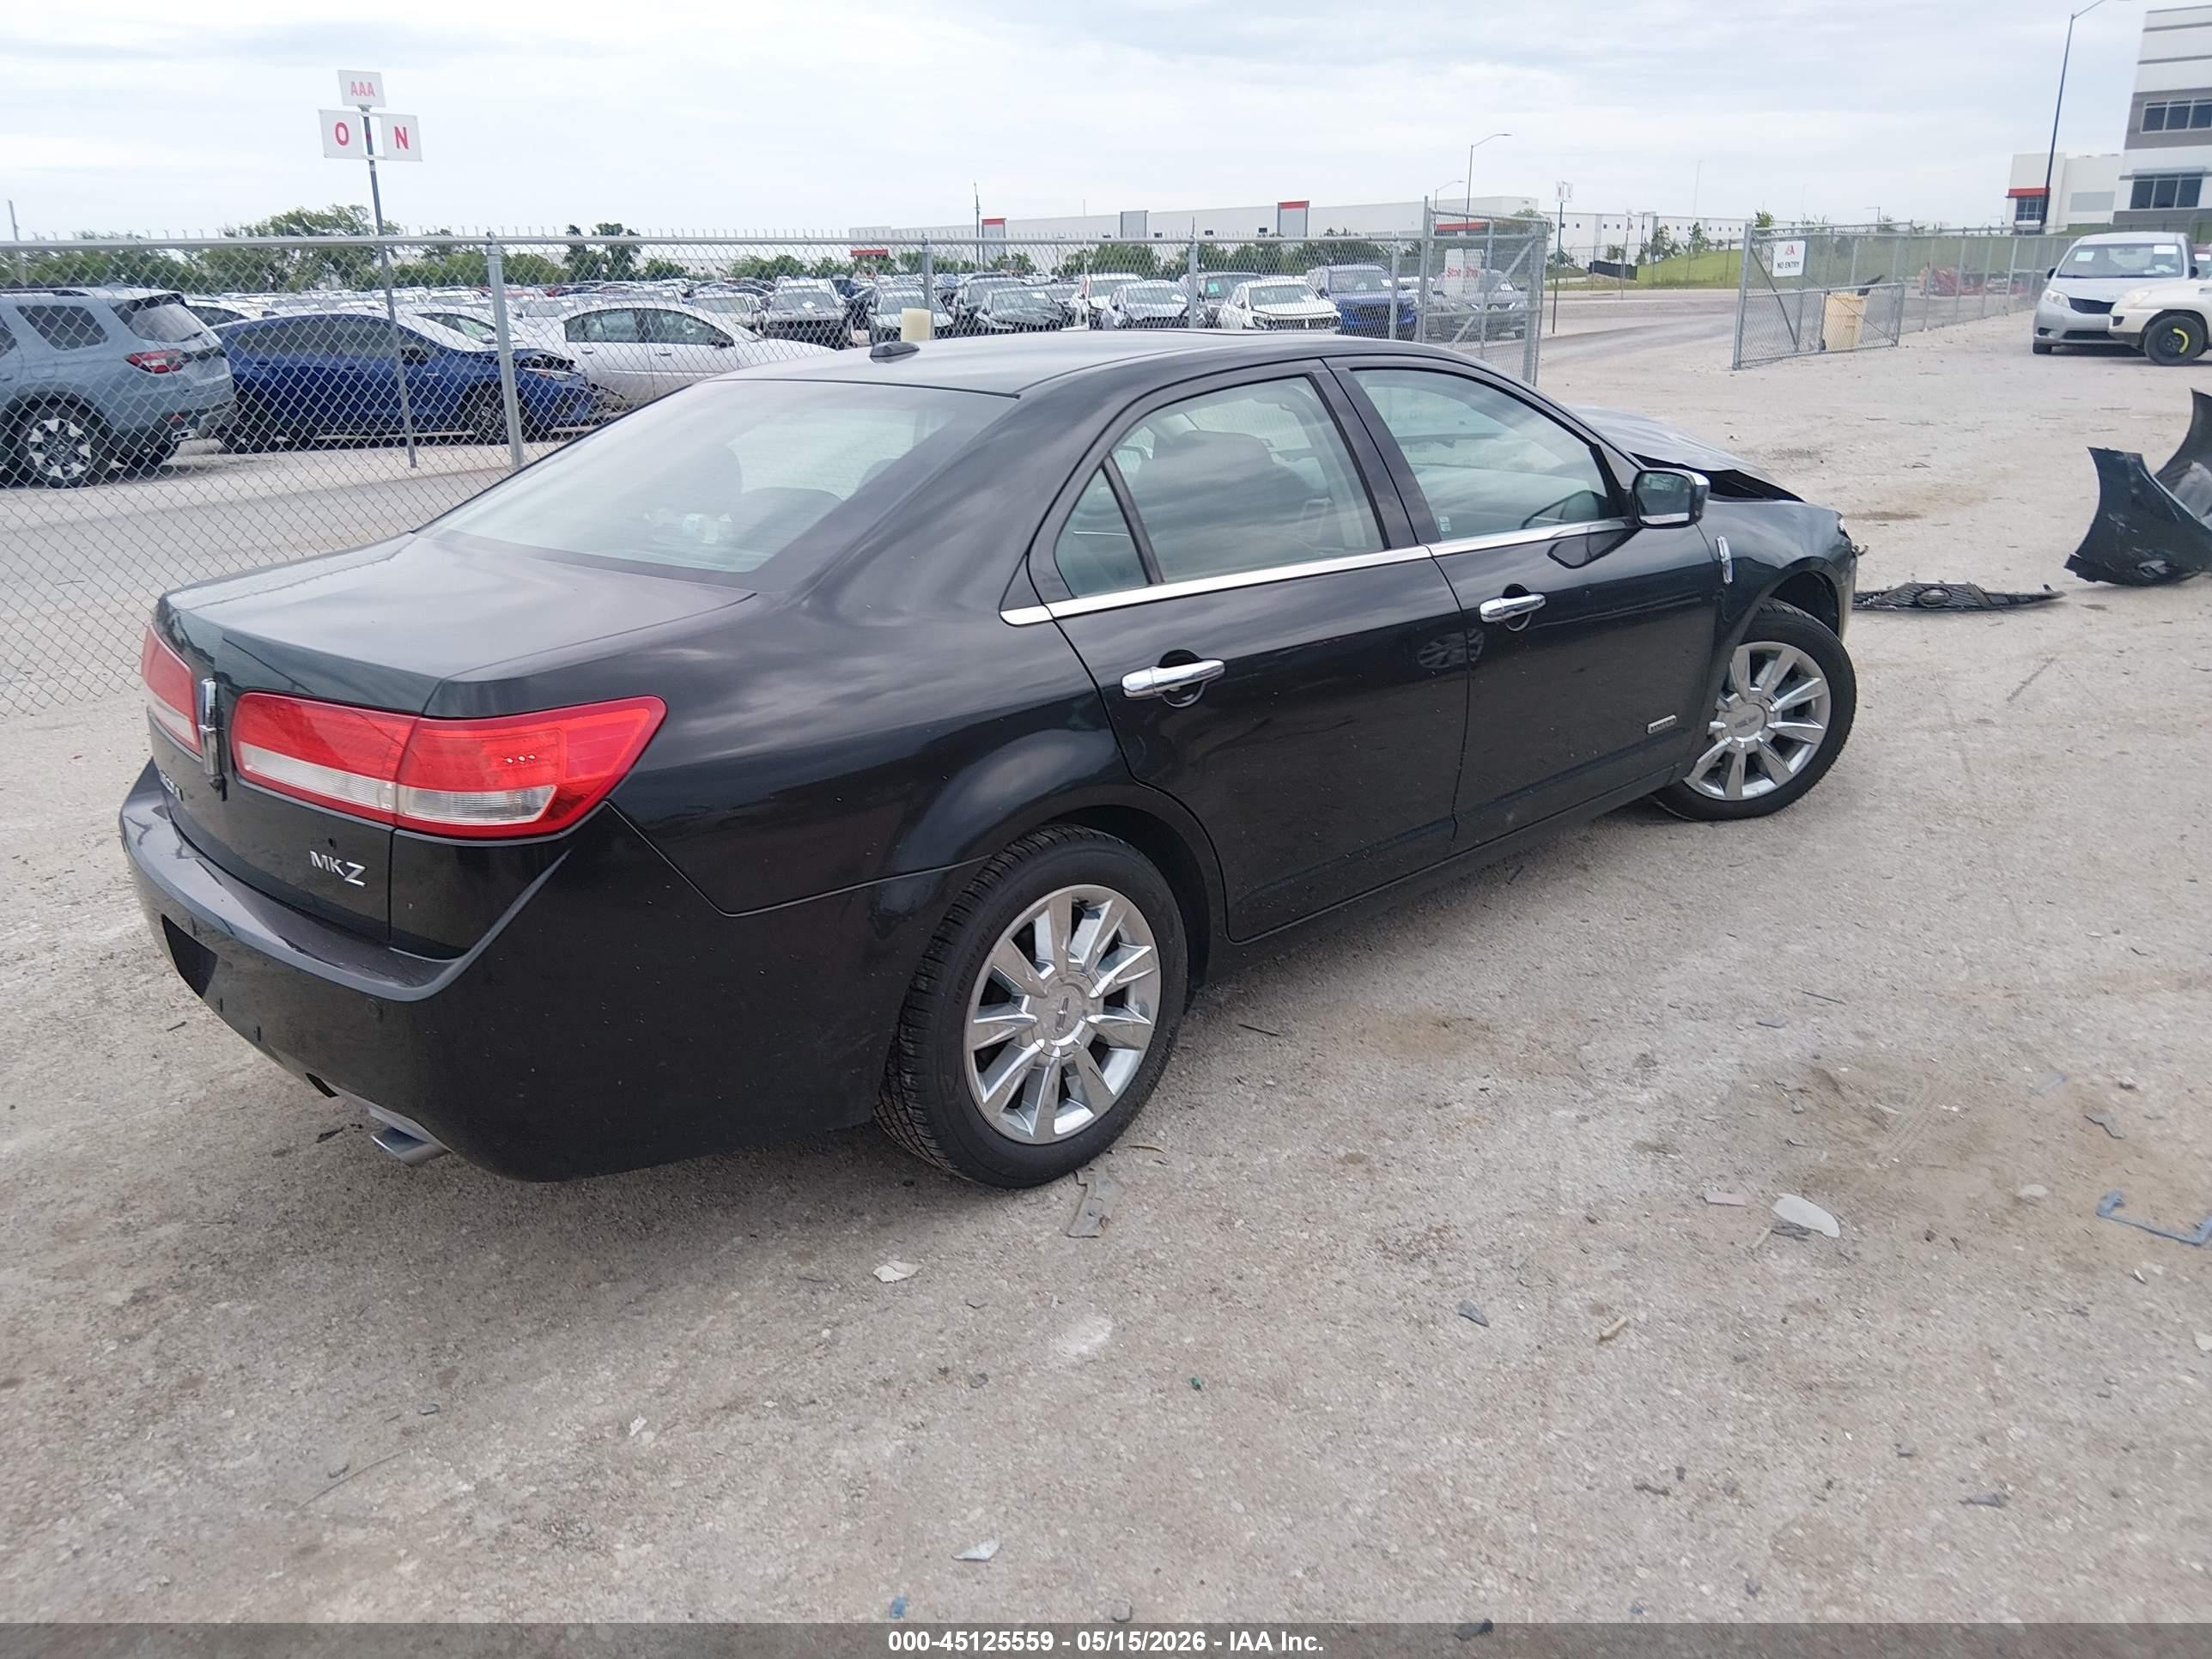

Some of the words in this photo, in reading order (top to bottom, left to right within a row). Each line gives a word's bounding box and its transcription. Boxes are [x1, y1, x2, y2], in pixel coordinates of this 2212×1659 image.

[350, 81, 376, 97] AAA
[335, 122, 349, 146] O
[394, 126, 409, 149] N
[310, 850, 367, 887] MKZ
